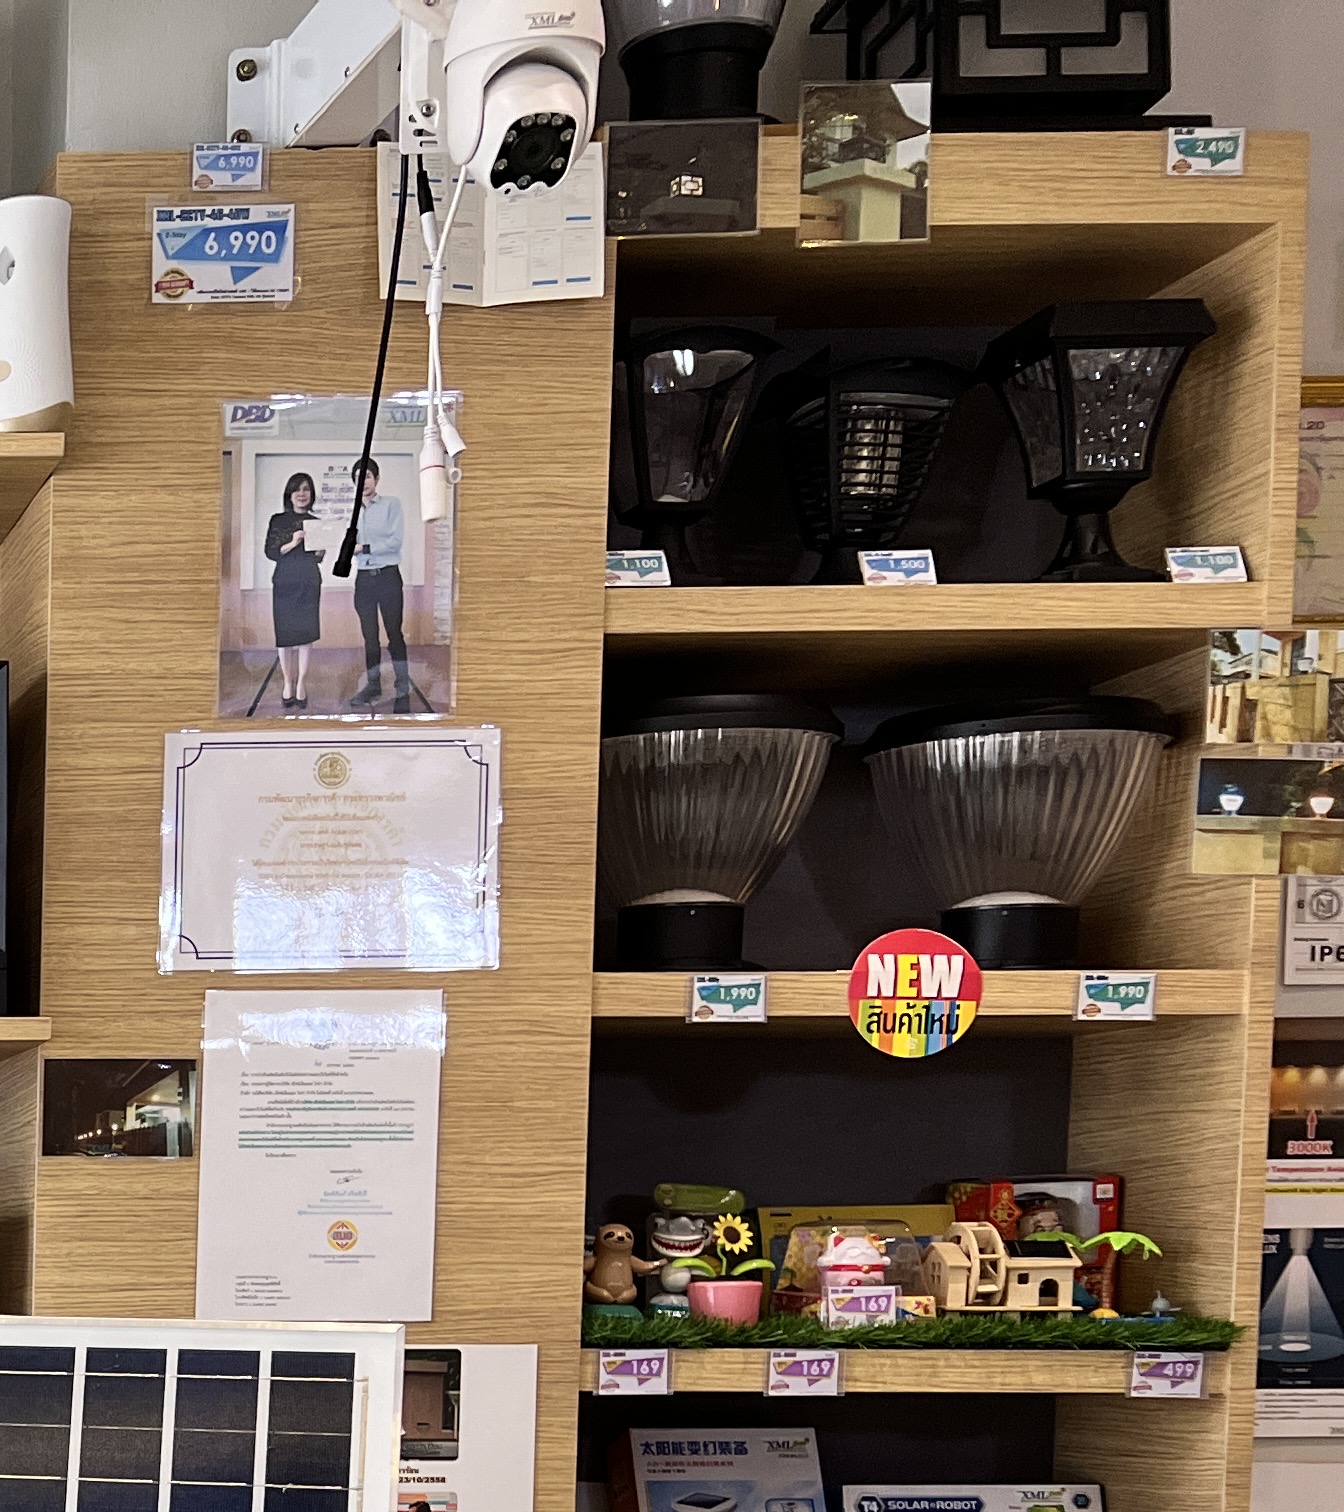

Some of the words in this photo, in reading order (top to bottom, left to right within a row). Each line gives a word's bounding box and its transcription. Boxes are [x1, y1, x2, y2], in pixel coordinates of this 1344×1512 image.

[1196, 139, 1235, 154] 2,490
[218, 155, 255, 170] 6,990
[204, 230, 277, 258] 6,990
[867, 954, 963, 997] NEW
[718, 987, 755, 1001] 1,990
[1106, 984, 1144, 999] 1,990
[866, 1002, 960, 1035] สินค้าใหม่
[858, 1295, 889, 1313] 169
[631, 1361, 660, 1376] 169
[801, 1361, 830, 1376] 169
[887, 1500, 930, 1510] SOLAR
[936, 1500, 977, 1511] ROBOT
